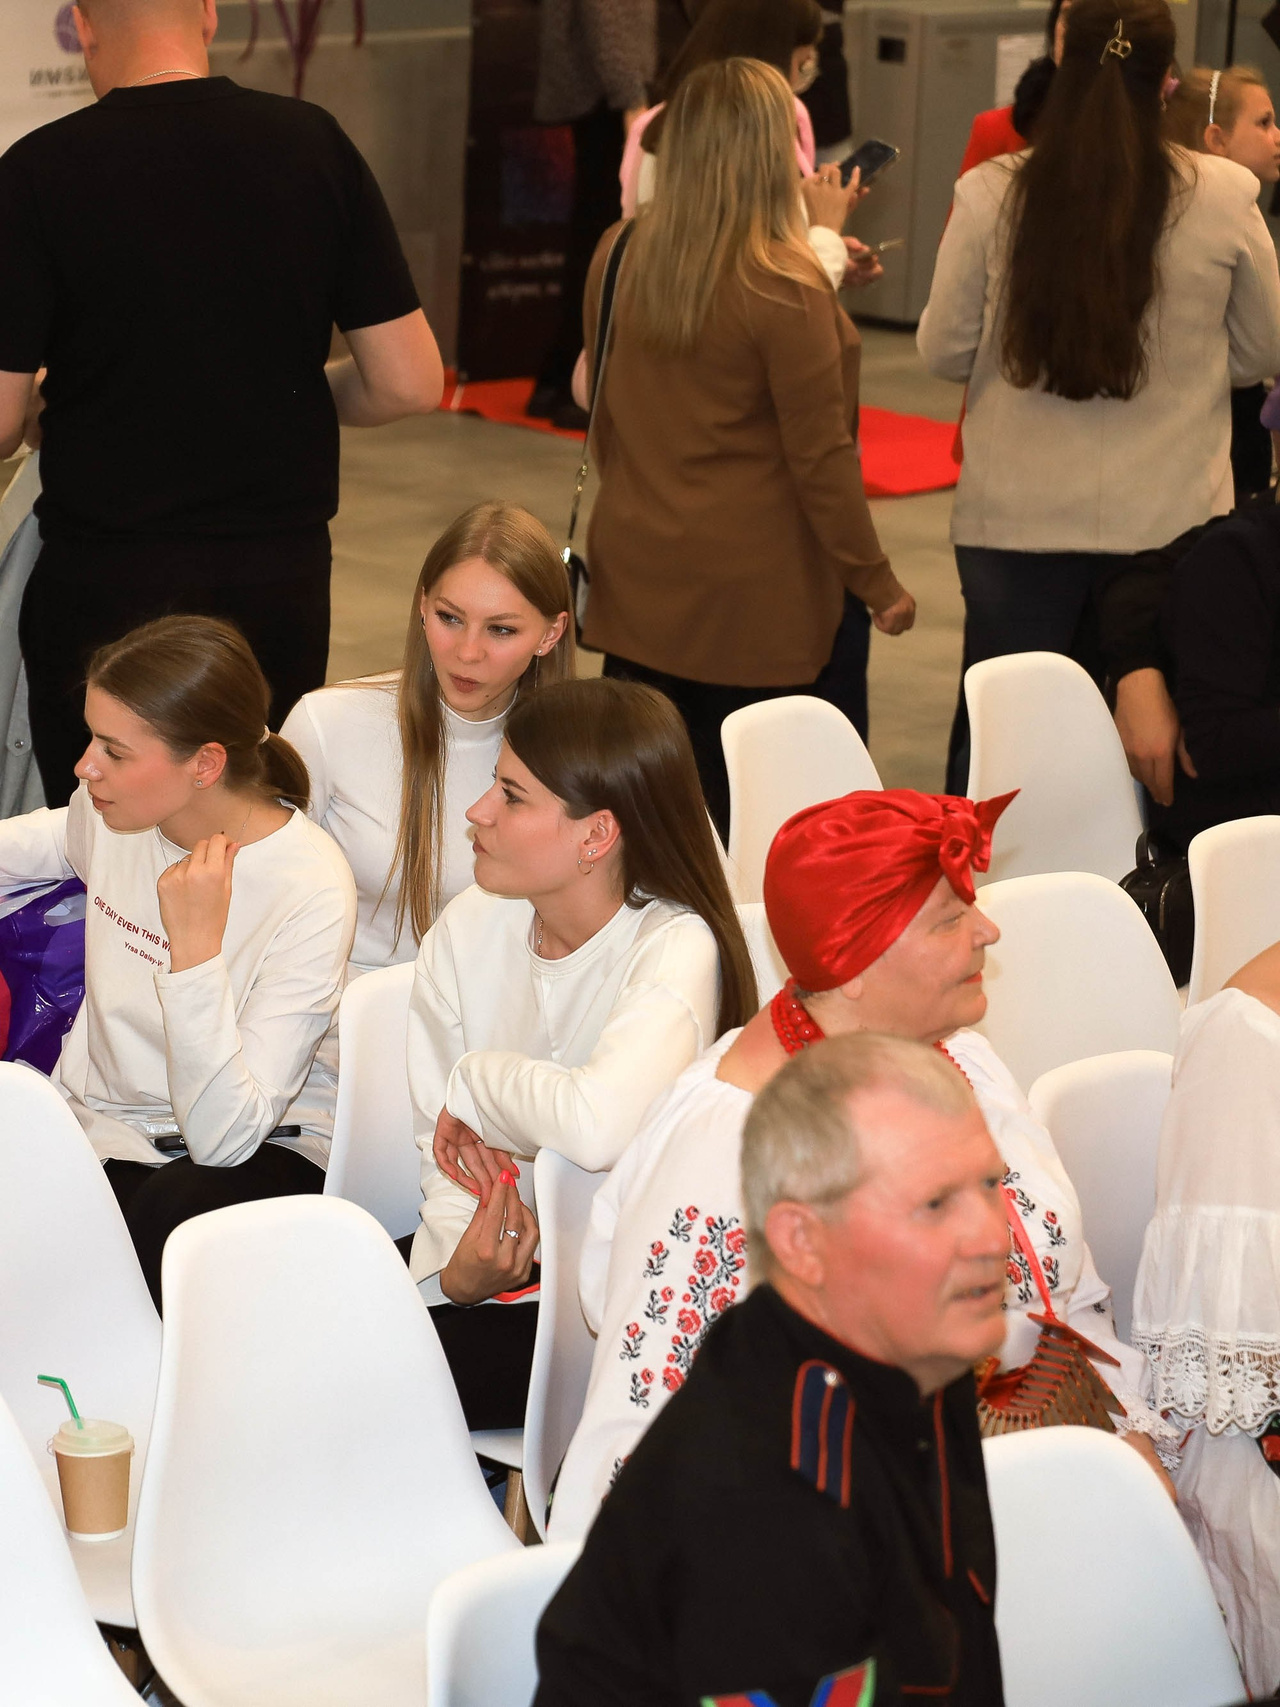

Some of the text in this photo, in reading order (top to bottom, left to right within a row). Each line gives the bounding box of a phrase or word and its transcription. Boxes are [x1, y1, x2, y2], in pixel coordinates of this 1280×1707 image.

[94, 896, 106, 911] ONE
[105, 906, 118, 920] DAY
[117, 916, 139, 934] EVEN
[142, 929, 160, 945] THIS
[125, 942, 164, 967] Yrsa Daley-W
